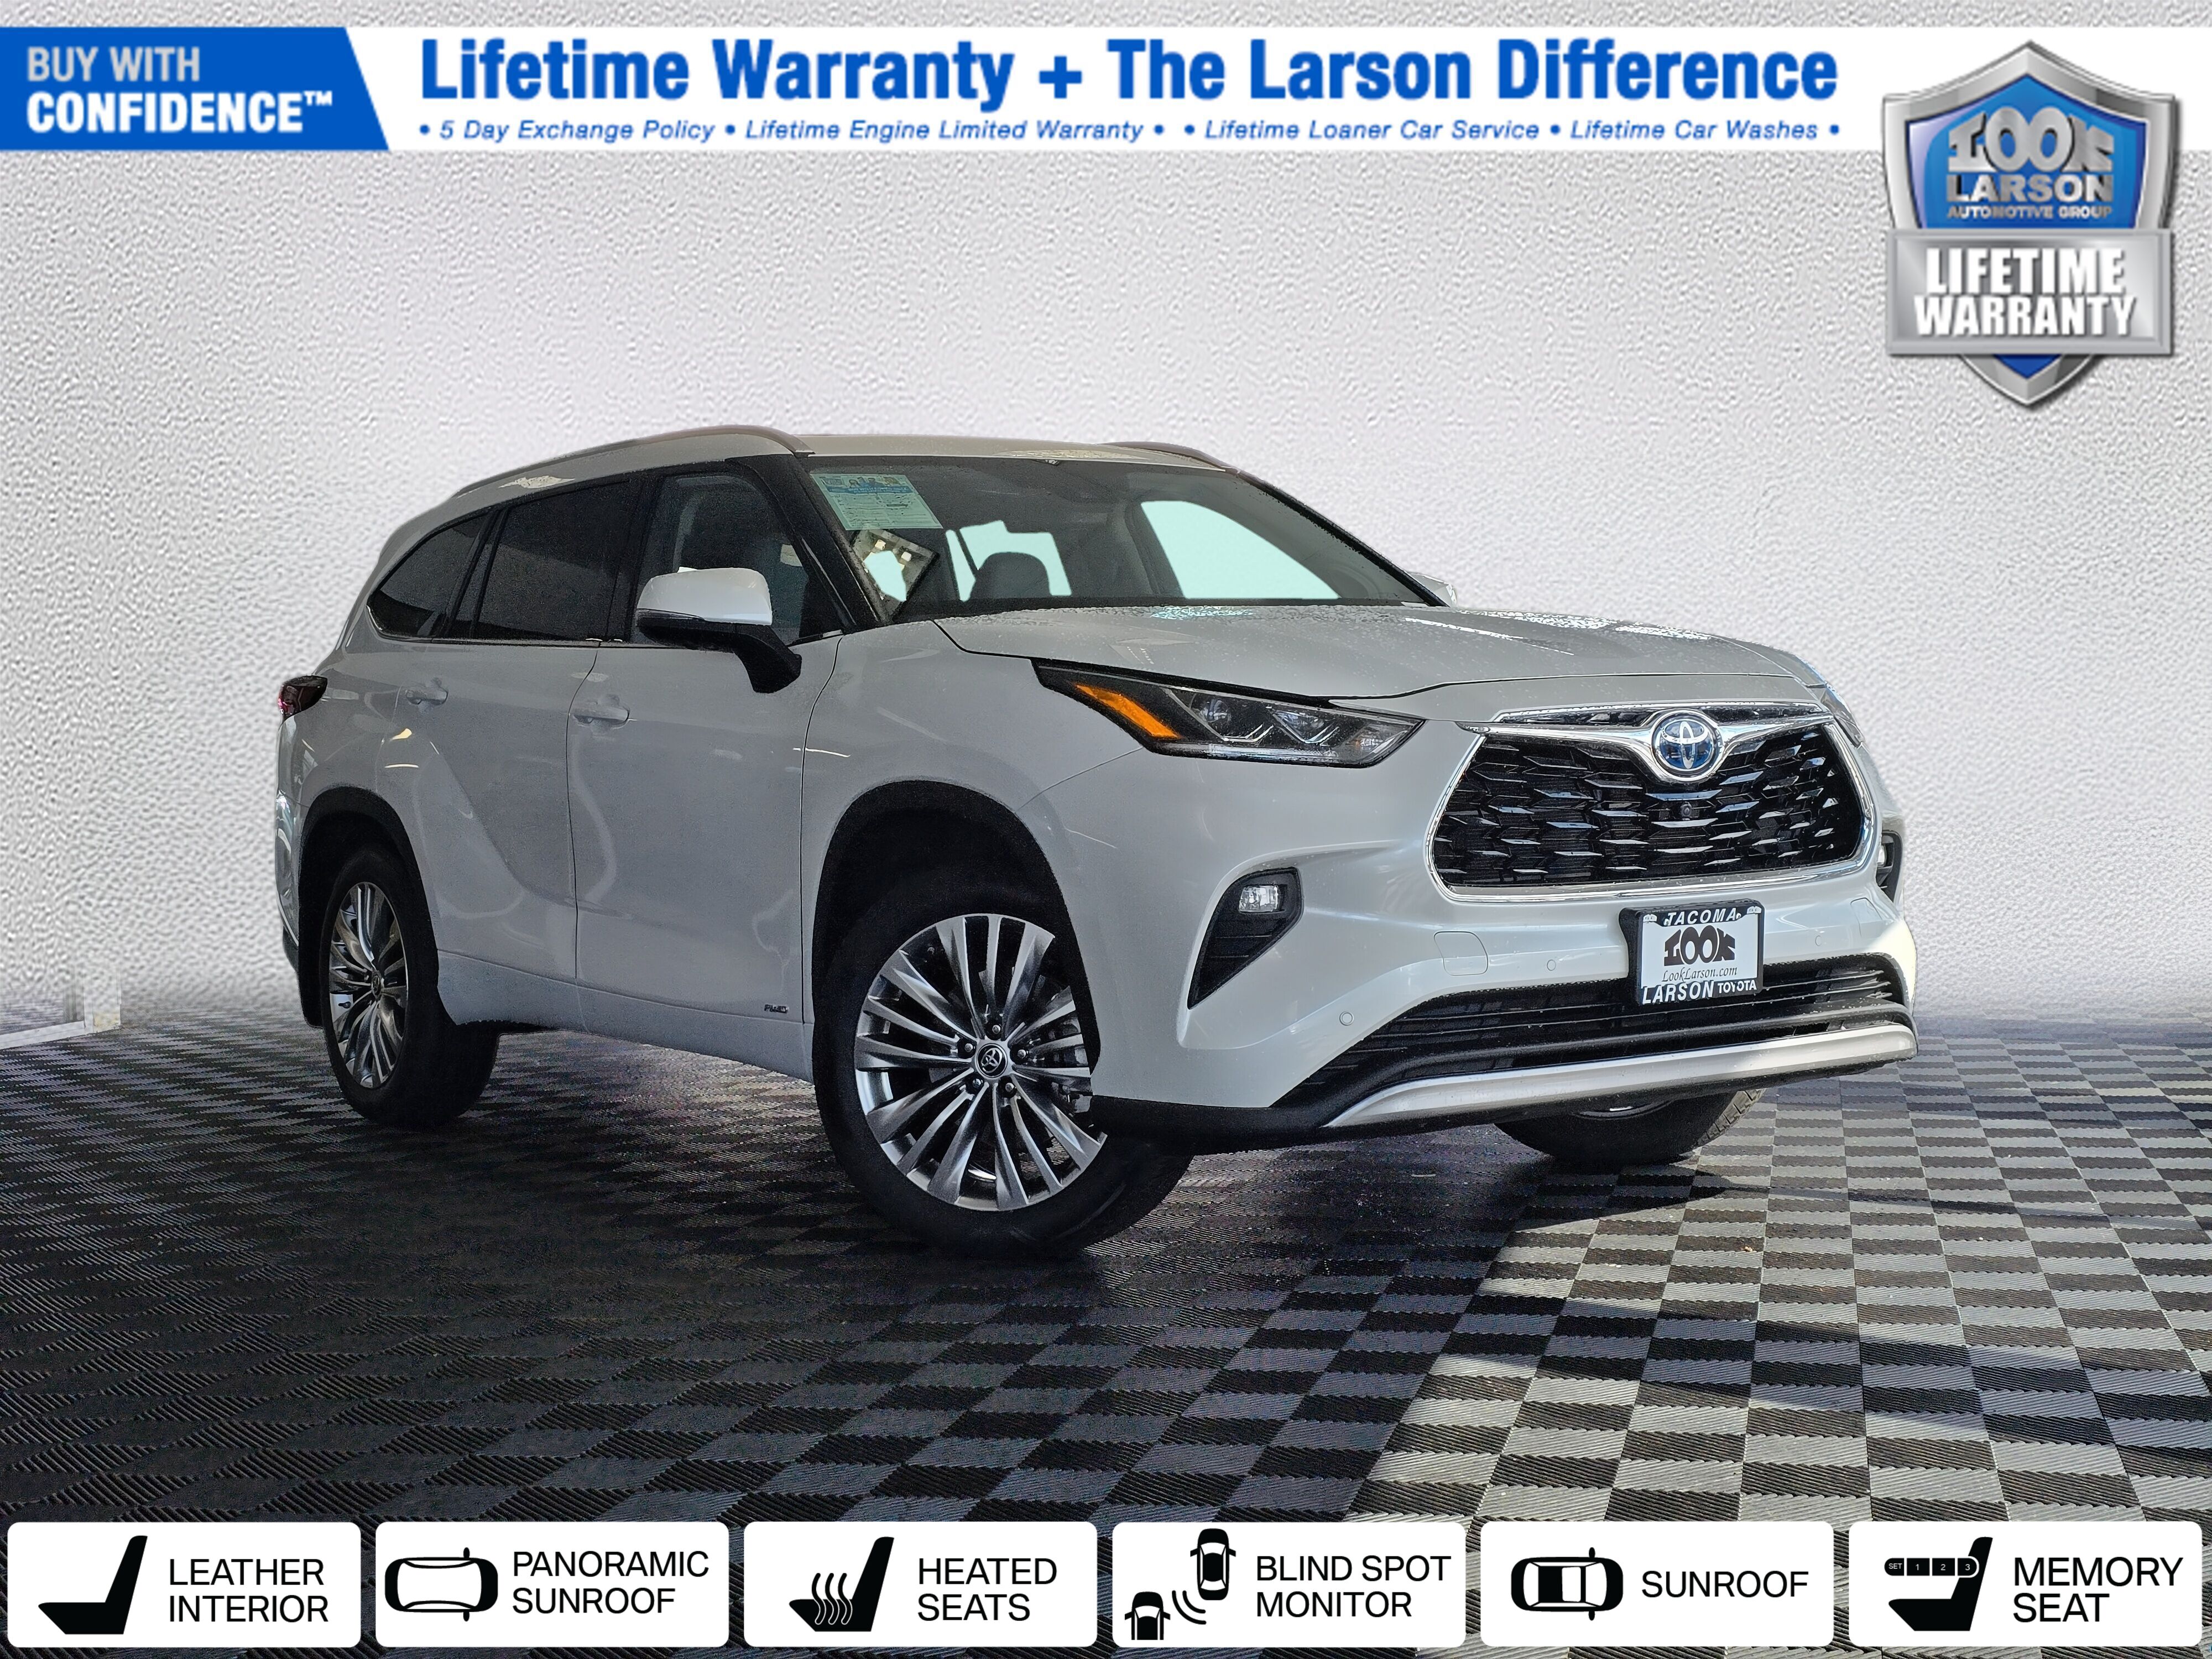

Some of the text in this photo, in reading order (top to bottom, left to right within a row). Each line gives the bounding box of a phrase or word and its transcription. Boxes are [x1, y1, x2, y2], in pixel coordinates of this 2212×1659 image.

[1665, 907, 1736, 926] TACOMA
[1662, 966, 1738, 983] LookLarson.com
[1642, 979, 1757, 1004] LARSON TOYOTA
